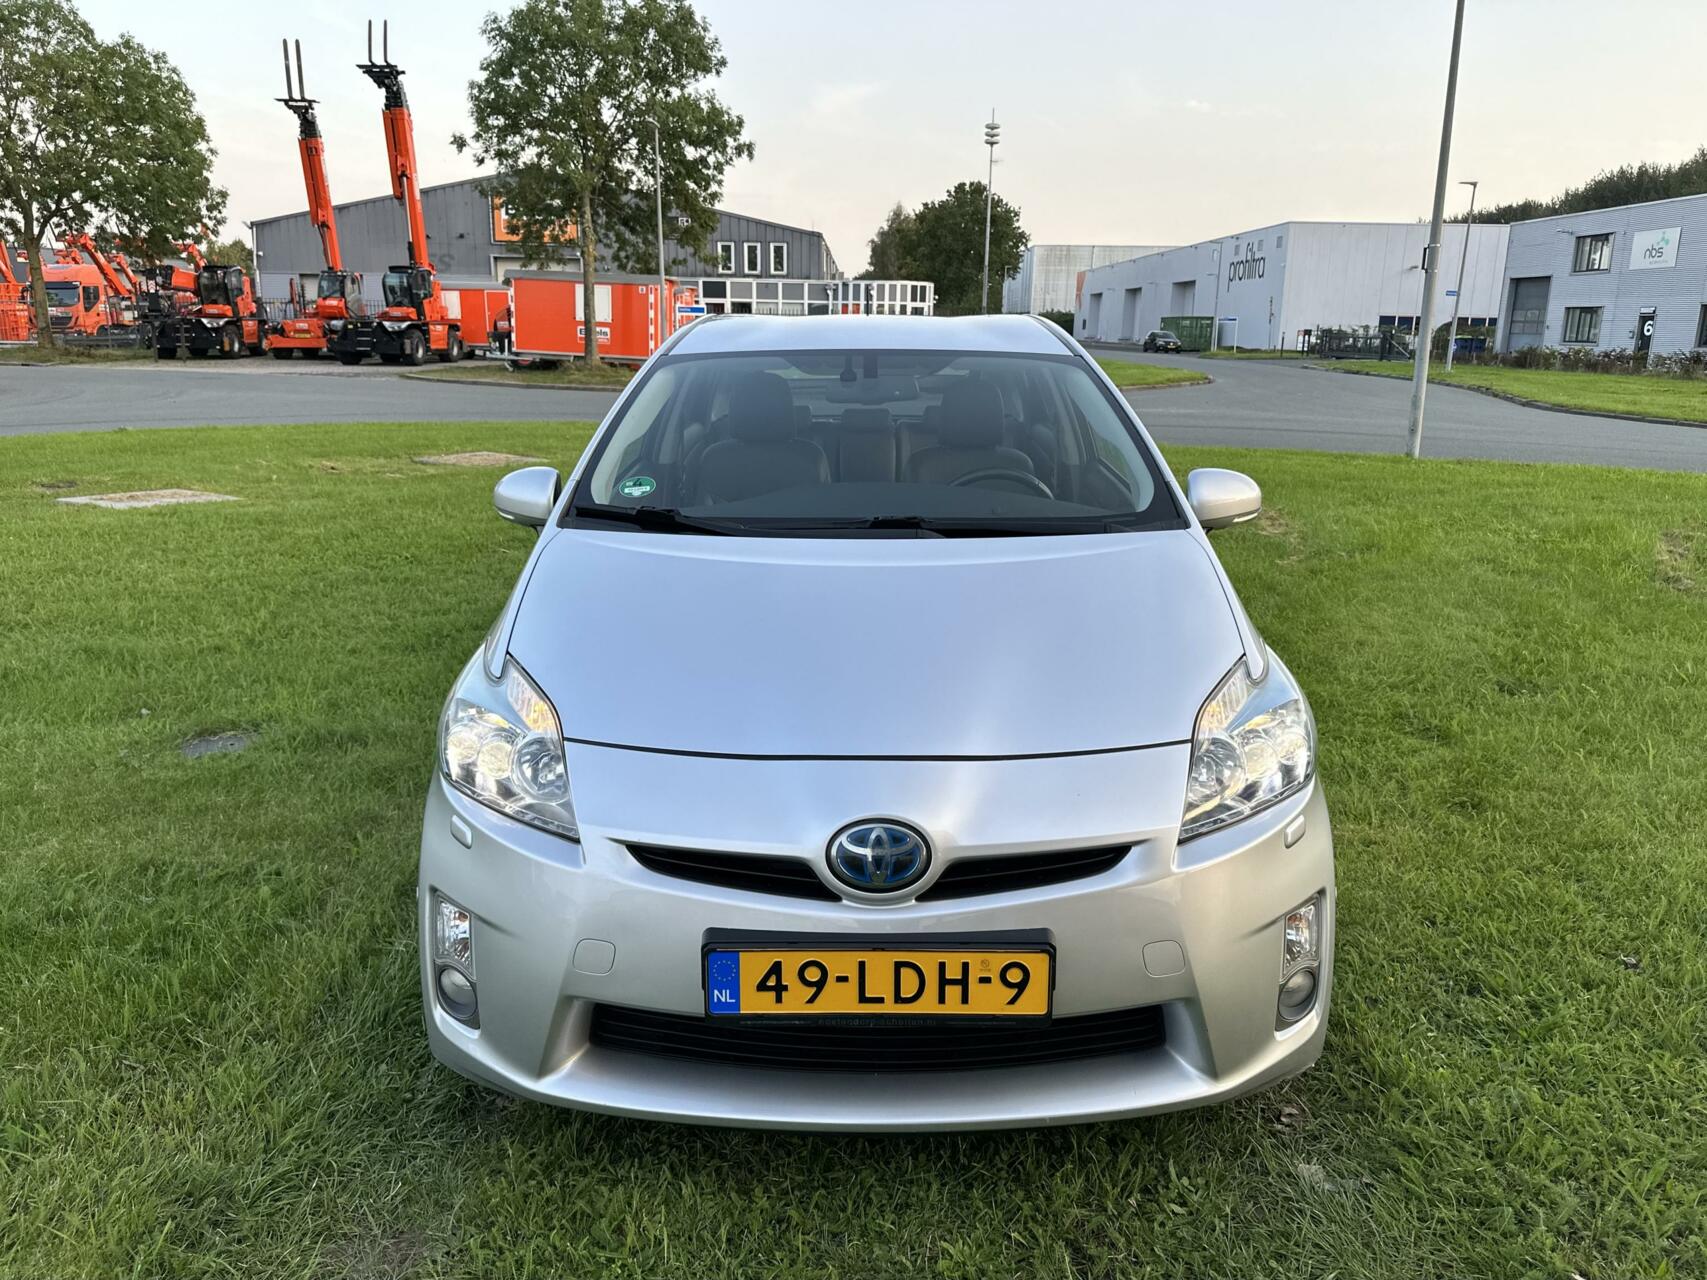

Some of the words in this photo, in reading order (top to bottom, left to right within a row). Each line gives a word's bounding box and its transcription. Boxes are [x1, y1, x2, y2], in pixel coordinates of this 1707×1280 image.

[1643, 244, 1664, 259] nbs
[1227, 242, 1266, 292] profiltra
[1644, 320, 1654, 336] 6
[632, 478, 642, 487] 4
[756, 959, 1031, 1005] 49-LDH-9
[713, 989, 736, 1003] NL
